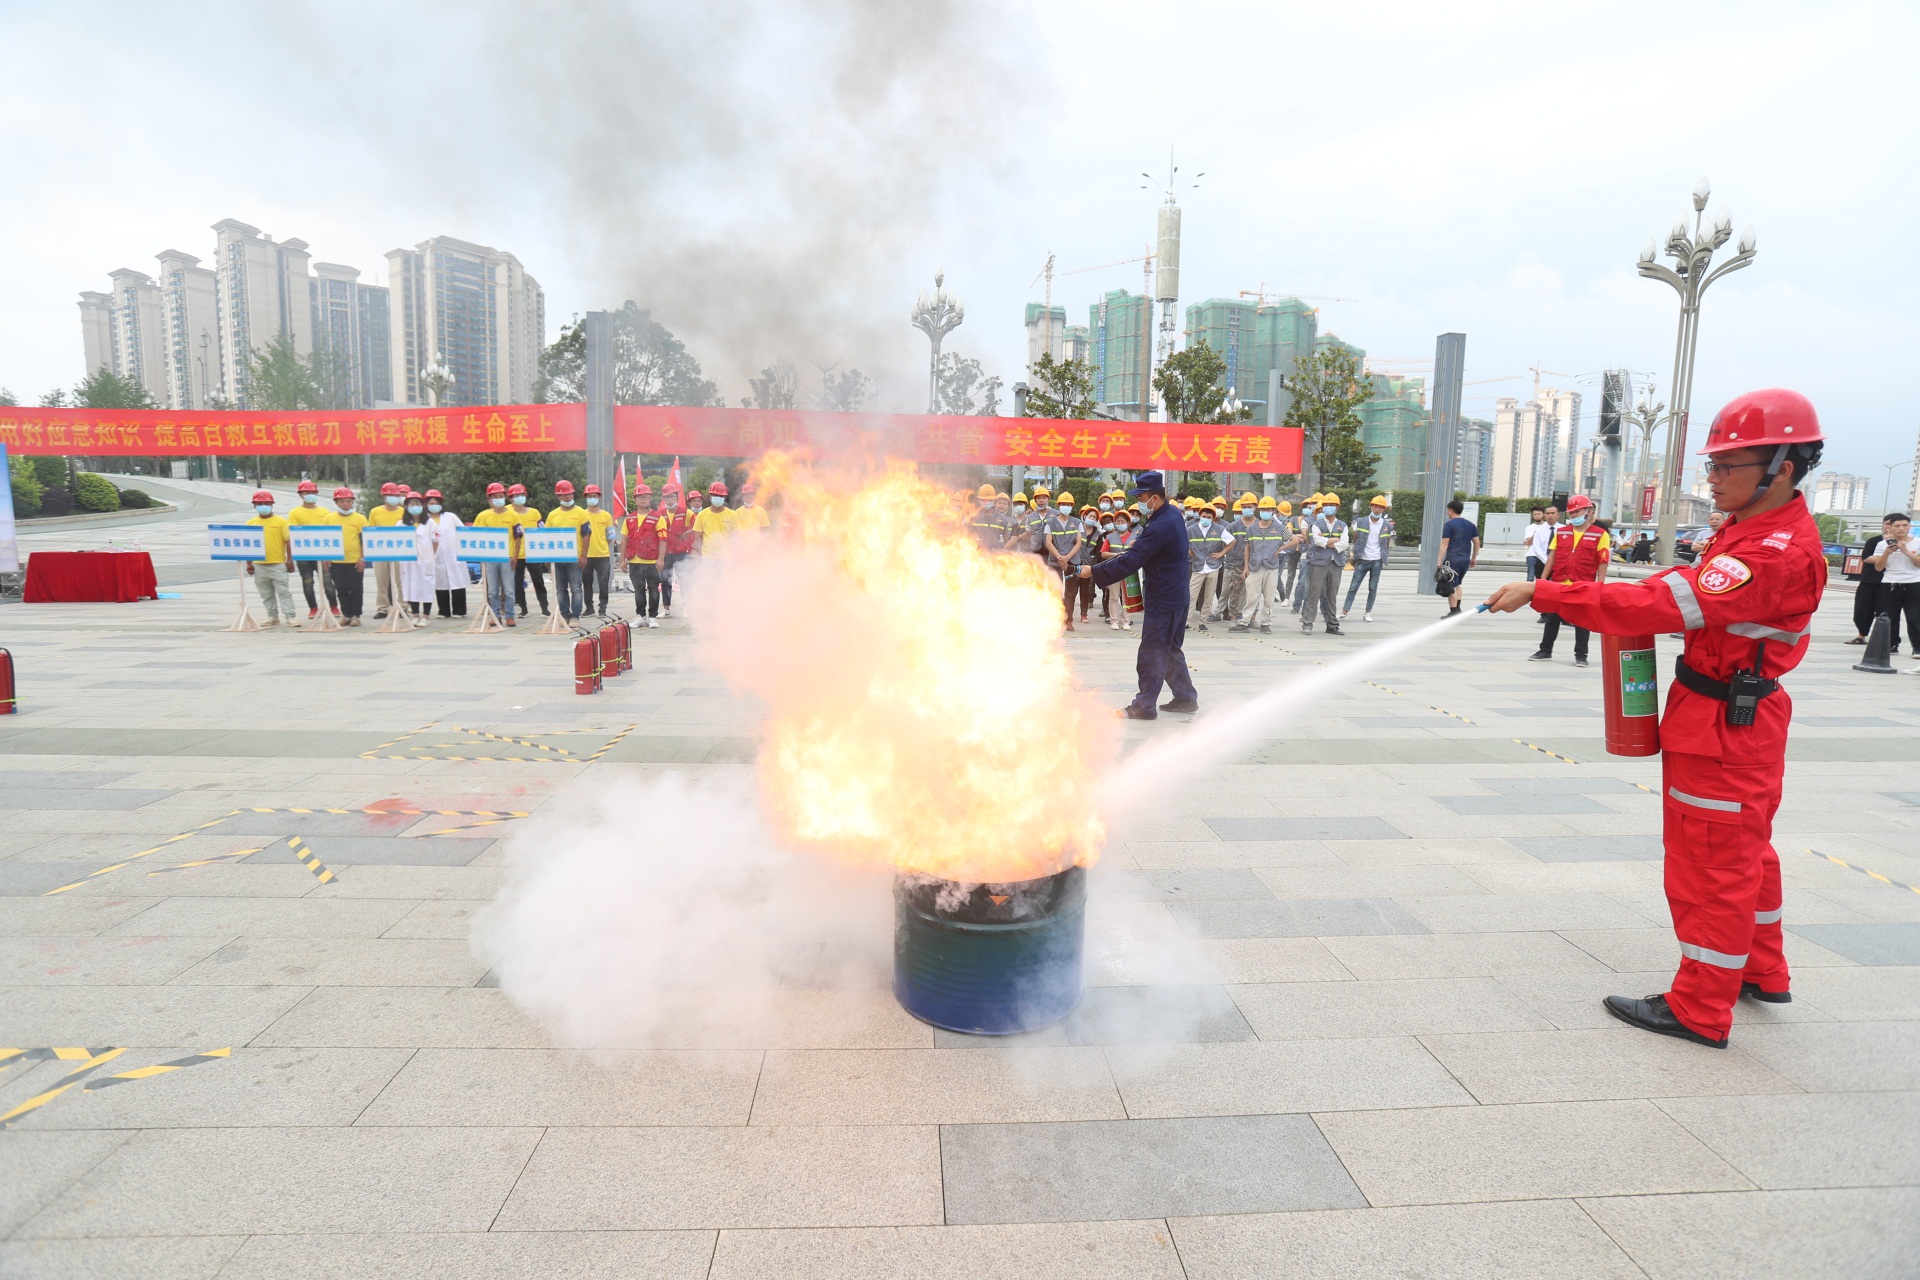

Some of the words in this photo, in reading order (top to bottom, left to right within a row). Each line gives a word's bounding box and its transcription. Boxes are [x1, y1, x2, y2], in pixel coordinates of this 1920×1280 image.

[356, 415, 449, 446] 科学救援
[462, 412, 555, 445] 生命至上
[1004, 426, 1132, 460] 安全生产
[1150, 431, 1272, 465] 人人有责
[213, 538, 261, 547] 后勤保障组
[367, 539, 413, 548] 医疗救护组
[529, 540, 574, 550] 安全通讯组
